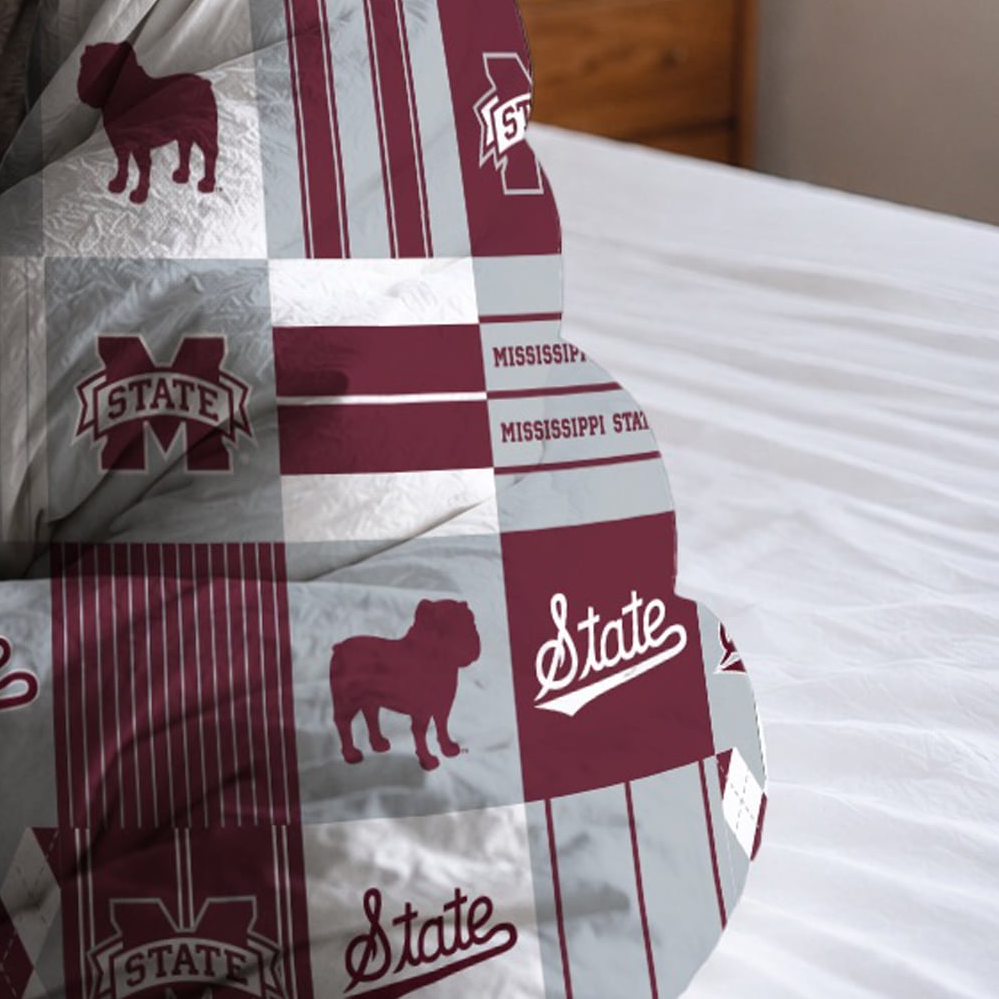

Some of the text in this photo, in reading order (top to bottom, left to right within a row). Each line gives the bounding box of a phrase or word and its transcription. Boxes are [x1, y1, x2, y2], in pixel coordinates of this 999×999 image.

[107, 379, 221, 419] STATE
[500, 410, 650, 443] MISSISSIPPI STAT
[534, 591, 688, 717] State
[125, 943, 249, 987] STATE
[343, 887, 518, 999] State
